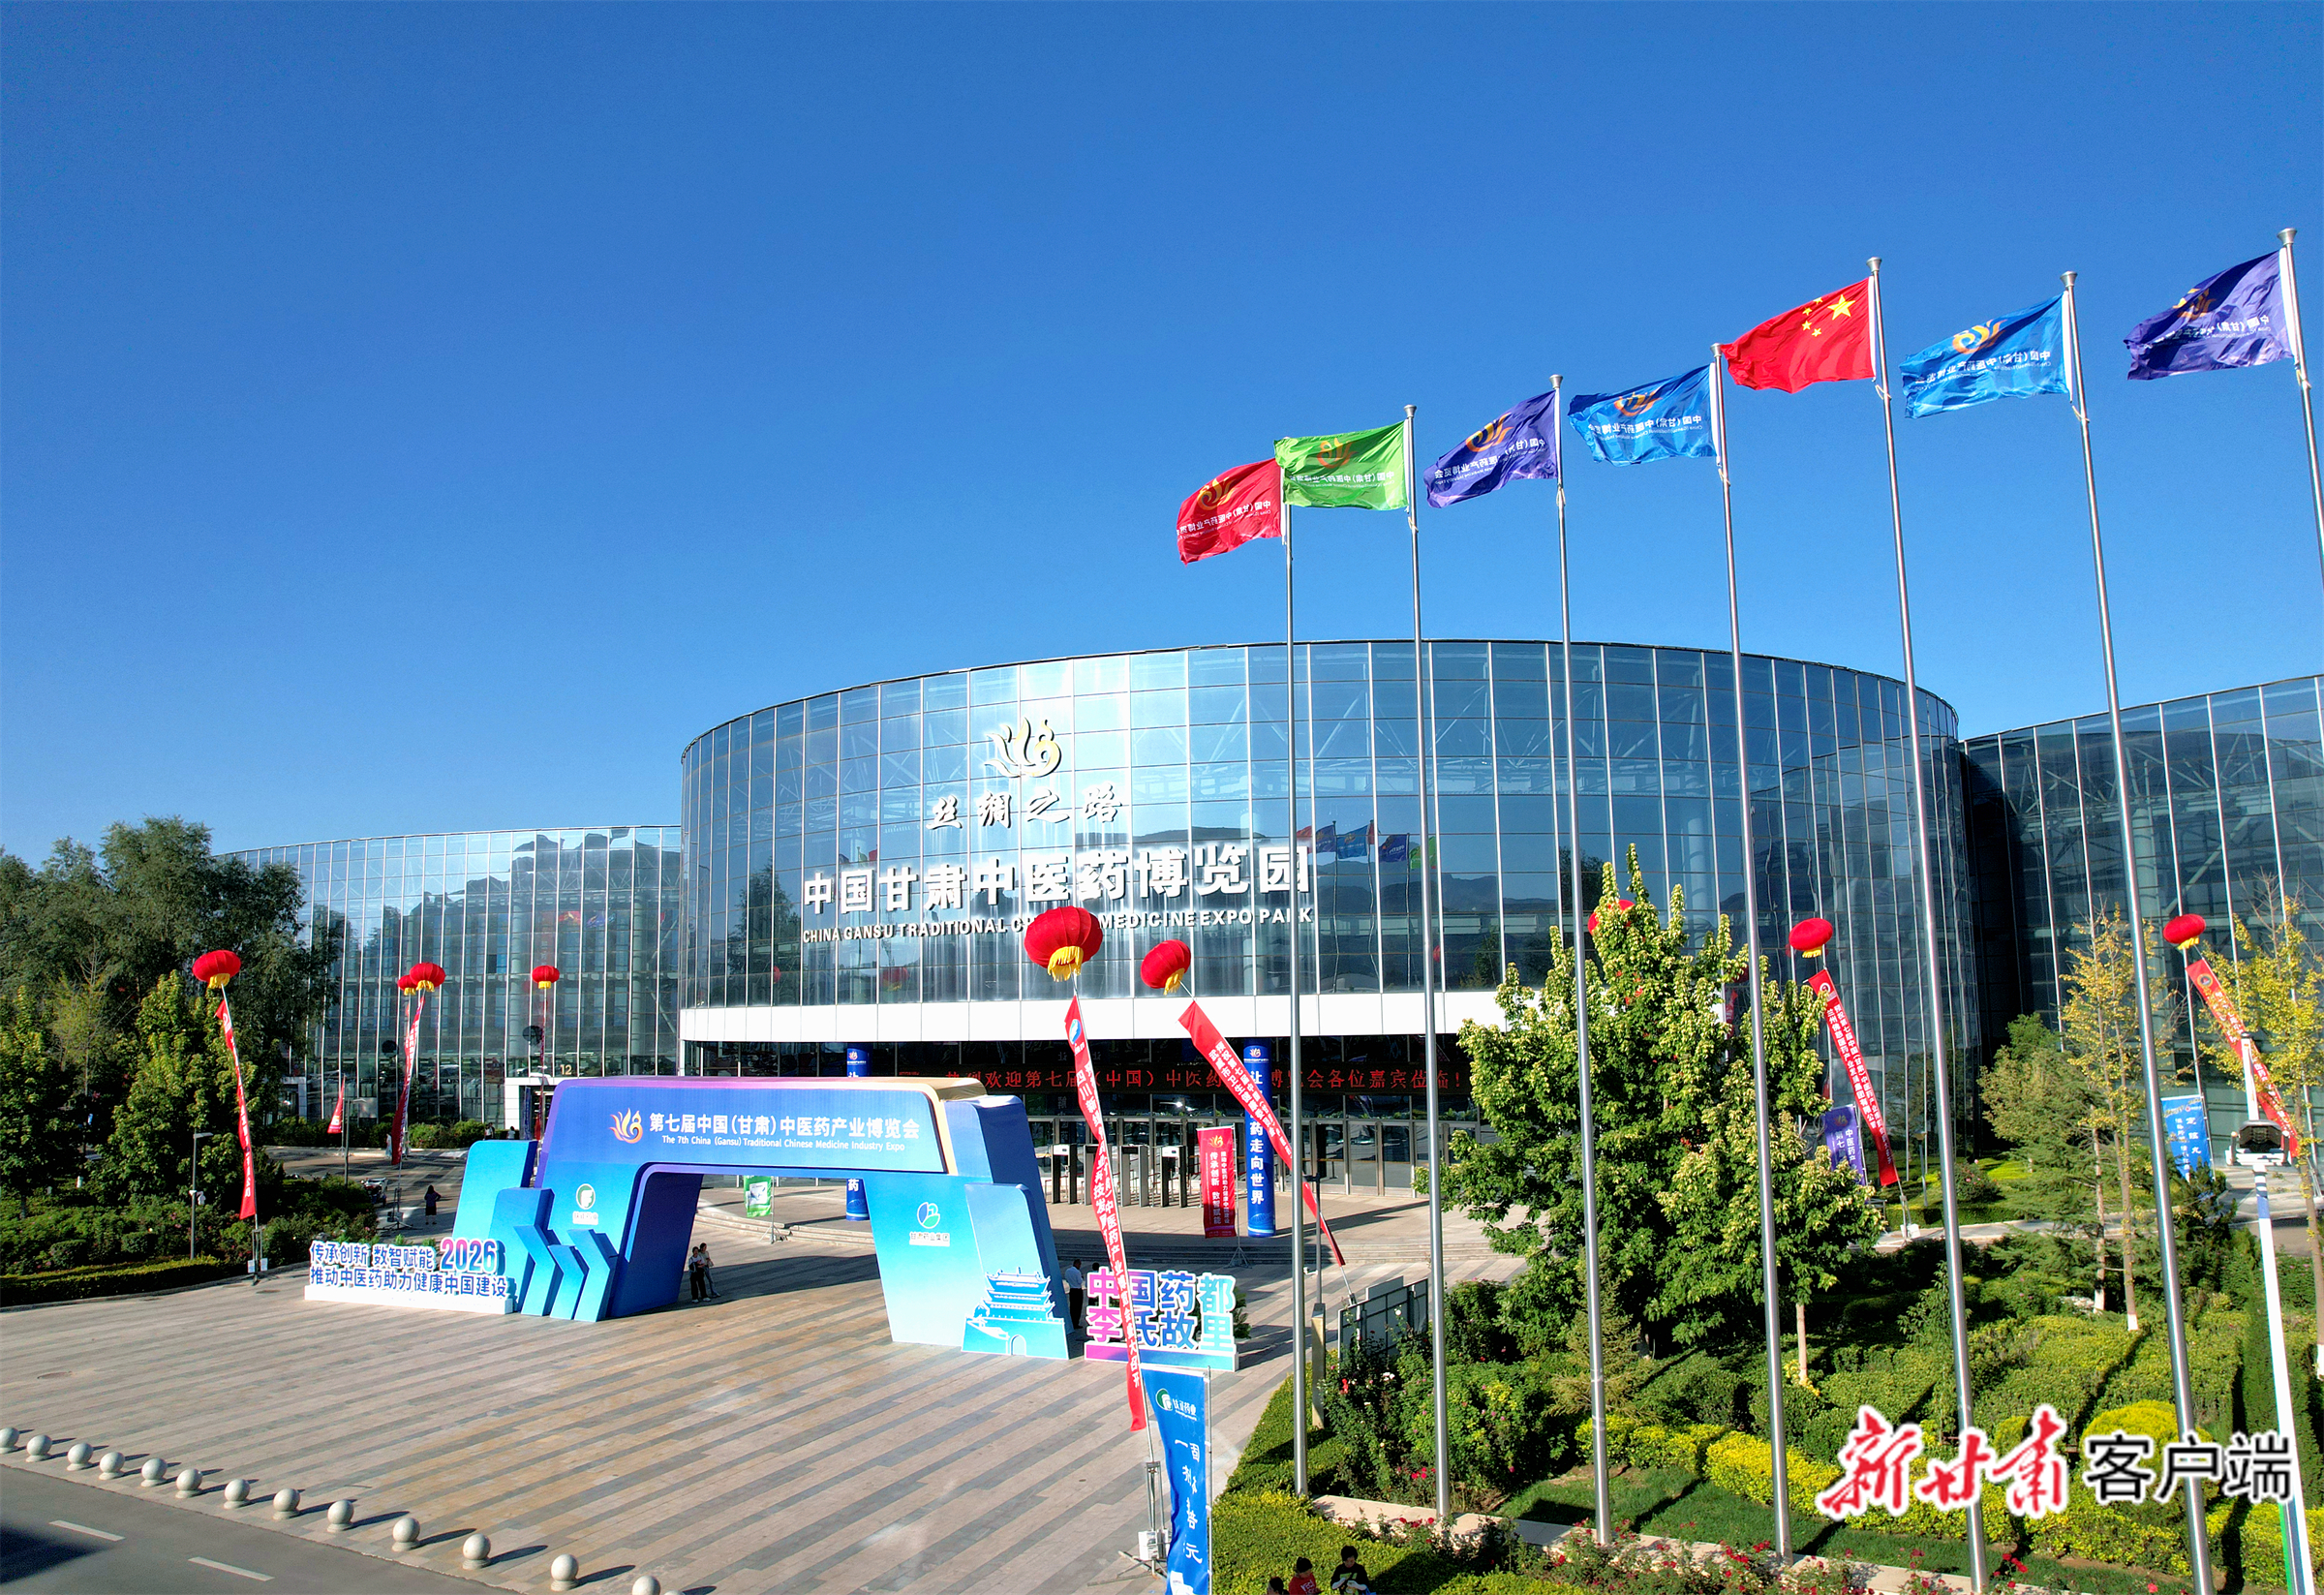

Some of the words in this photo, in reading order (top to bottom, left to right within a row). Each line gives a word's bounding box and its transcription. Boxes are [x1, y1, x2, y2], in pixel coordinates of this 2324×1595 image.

[926, 782, 1123, 831] 丝绸之路
[803, 844, 1312, 914] 中国甘肃中医药博览园
[803, 928, 841, 943] CHINA
[843, 925, 894, 940] GANSU
[899, 919, 1007, 937] TRADITIONAL
[1099, 911, 1196, 929] MEDICINE
[1200, 908, 1254, 926] EXPO
[1259, 907, 1313, 924] PAK
[561, 1064, 572, 1075] 12
[945, 1069, 1460, 1089] 欢迎第七届（中国）中医药博会各位嘉宾莅临！
[649, 1113, 920, 1140] 第七届中国（甘肃）中医药产业博览会
[662, 1135, 676, 1144] The
[678, 1135, 689, 1144] 7th
[691, 1136, 712, 1145] China
[715, 1136, 742, 1147] (Gansu)
[743, 1137, 781, 1148] Traditional
[783, 1139, 813, 1149] Chinese
[815, 1140, 849, 1150] Medicine
[851, 1141, 883, 1152] Industry
[886, 1142, 905, 1152] Expo
[1249, 1070, 1265, 1205] 让药走向世界
[1209, 1151, 1220, 1186] 传承创新
[309, 1242, 370, 1266] 传承创新
[372, 1245, 434, 1270] 数智赋能
[441, 1239, 497, 1273] 2026
[310, 1266, 506, 1298] 推动中医药助力健康中国建设
[1088, 1267, 1236, 1313] 中国药都
[1087, 1305, 1236, 1351] 李氏故里
